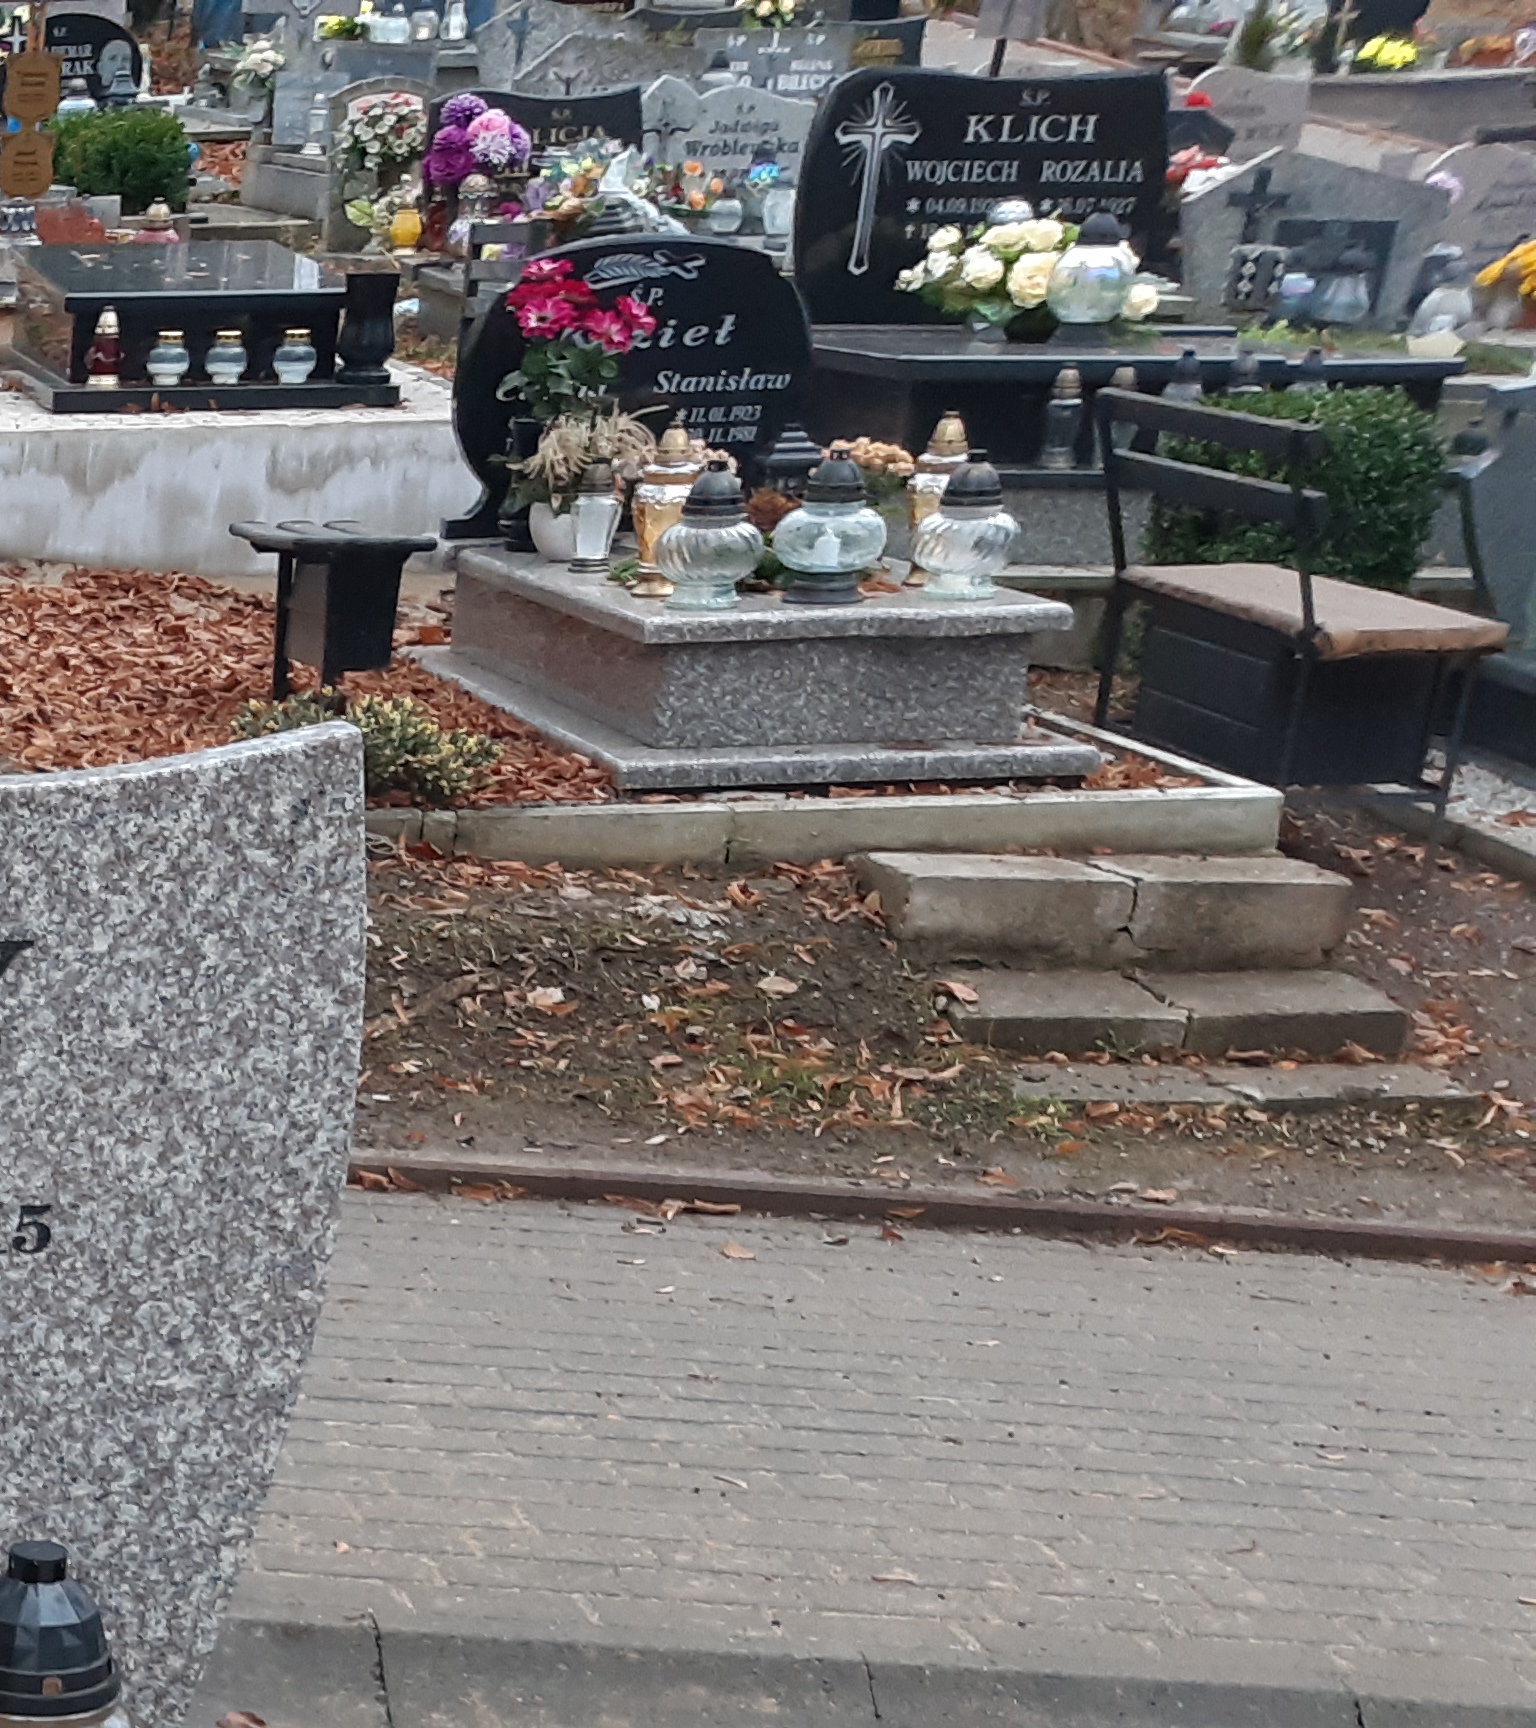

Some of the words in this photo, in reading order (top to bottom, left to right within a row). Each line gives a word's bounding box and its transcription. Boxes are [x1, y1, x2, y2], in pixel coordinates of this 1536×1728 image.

[530, 125, 608, 146] LICJA
[962, 113, 1100, 144] KLICH
[905, 160, 1020, 186] WOJCIECH
[1039, 159, 1145, 184] ROZALIA
[652, 366, 792, 395] Stanisław
